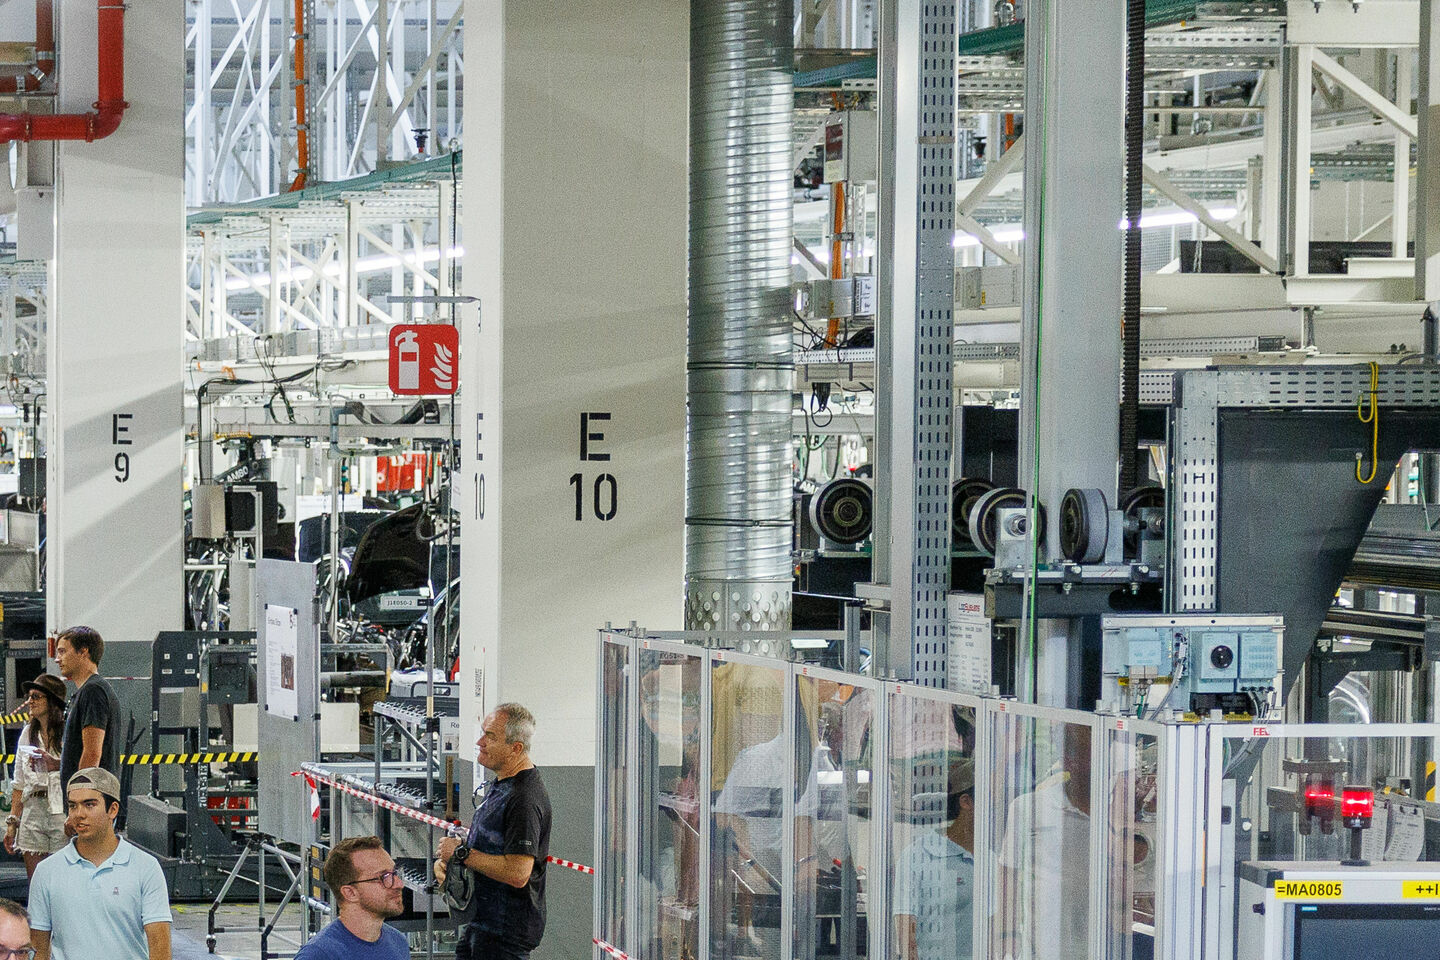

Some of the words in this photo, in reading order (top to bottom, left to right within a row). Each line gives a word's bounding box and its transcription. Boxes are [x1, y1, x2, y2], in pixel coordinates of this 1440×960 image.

[112, 414, 133, 445] E
[476, 413, 483, 461] E
[580, 412, 611, 461] E
[114, 452, 130, 483] 9
[475, 472, 485, 521] 10
[569, 473, 618, 521] 10
[1277, 883, 1342, 896] =MA0805
